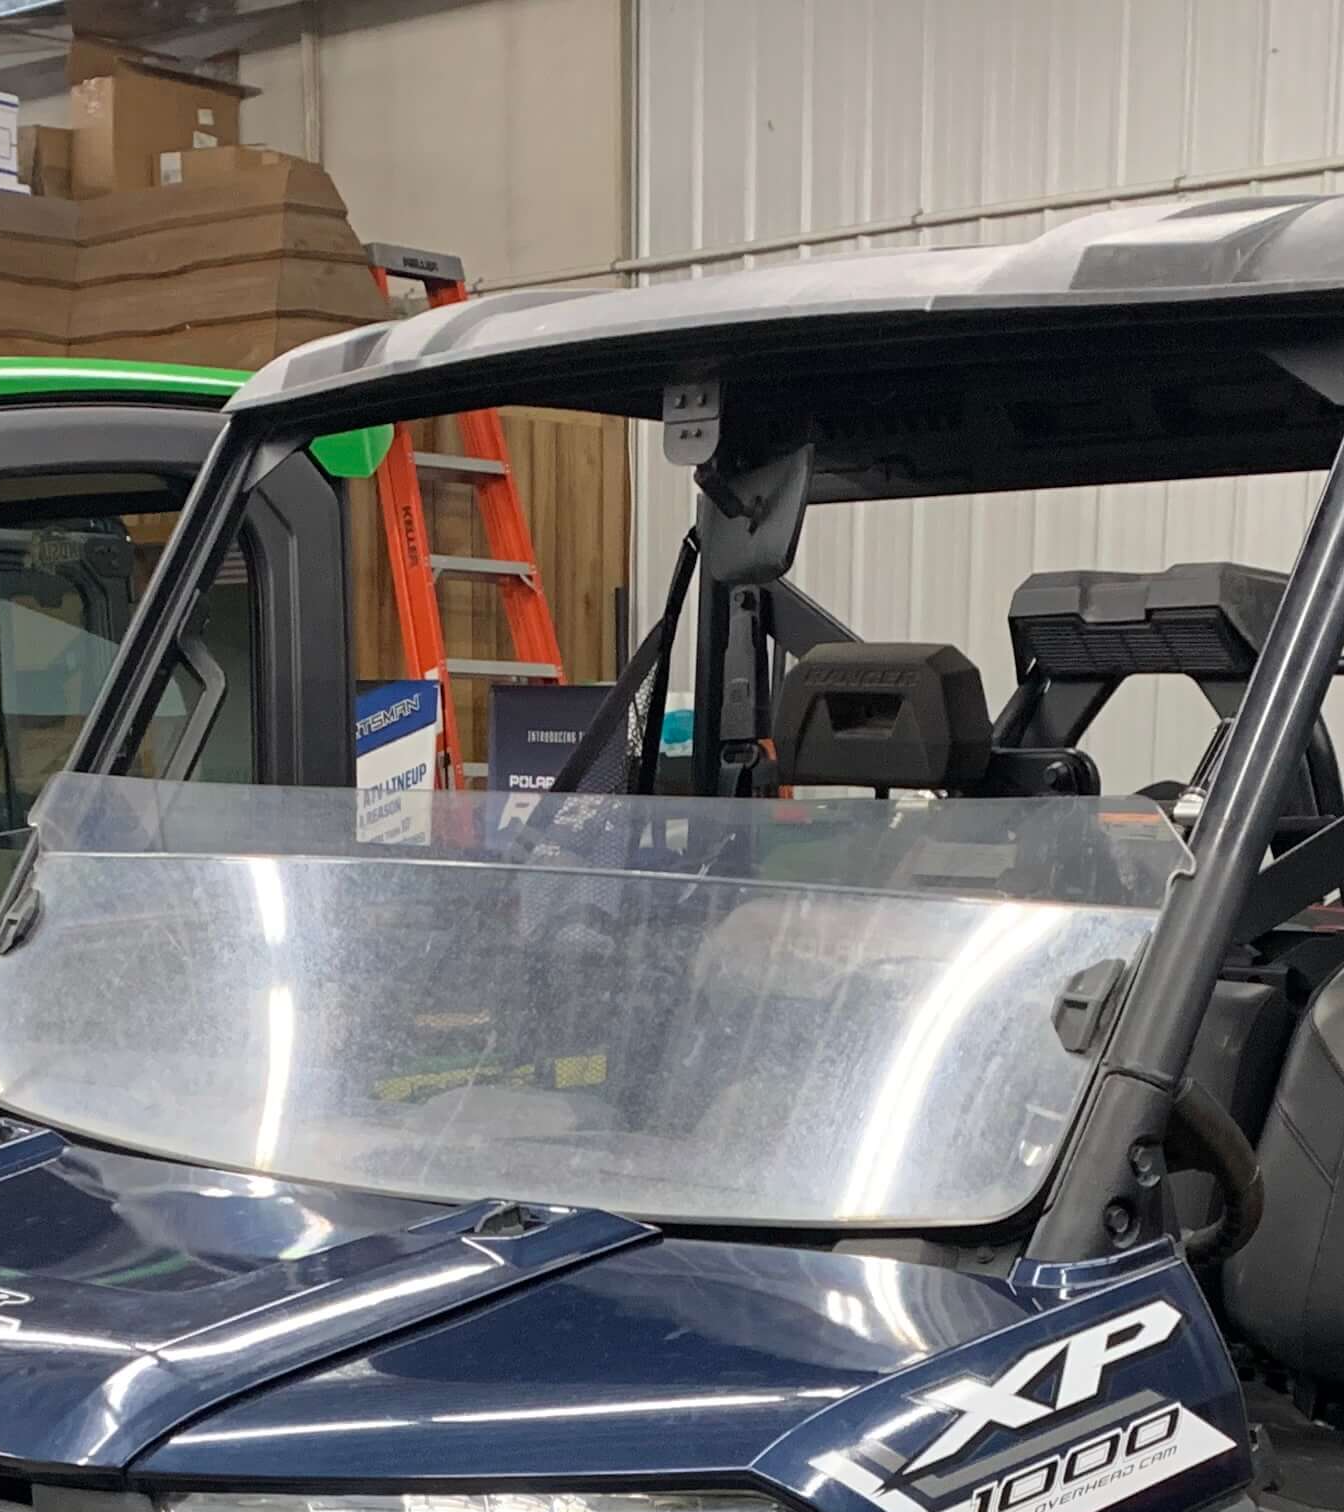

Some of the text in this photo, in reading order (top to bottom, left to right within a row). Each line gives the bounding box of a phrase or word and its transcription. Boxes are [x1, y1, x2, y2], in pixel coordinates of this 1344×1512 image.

[357, 693, 420, 739] TSMAN
[386, 763, 426, 795] LINEUP
[510, 775, 555, 788] POLAR
[901, 1300, 1182, 1475] XP
[1139, 1446, 1178, 1471] CAM
